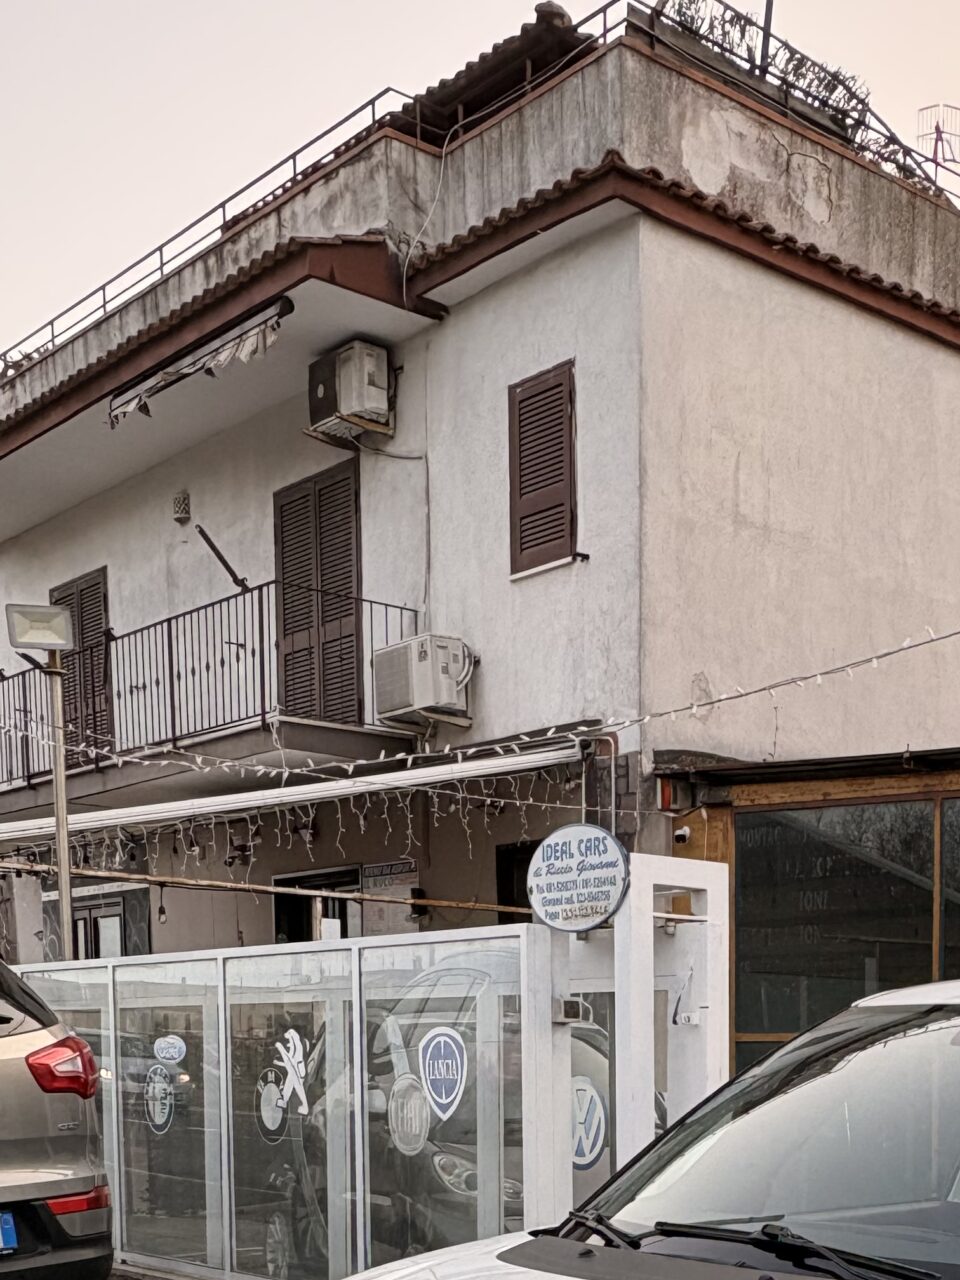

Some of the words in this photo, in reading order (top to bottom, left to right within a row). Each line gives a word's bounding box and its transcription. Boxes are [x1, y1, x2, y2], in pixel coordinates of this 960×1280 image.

[542, 840, 574, 862] IDEAL
[577, 836, 608, 858] CARS
[429, 1060, 458, 1079] LANCIA
